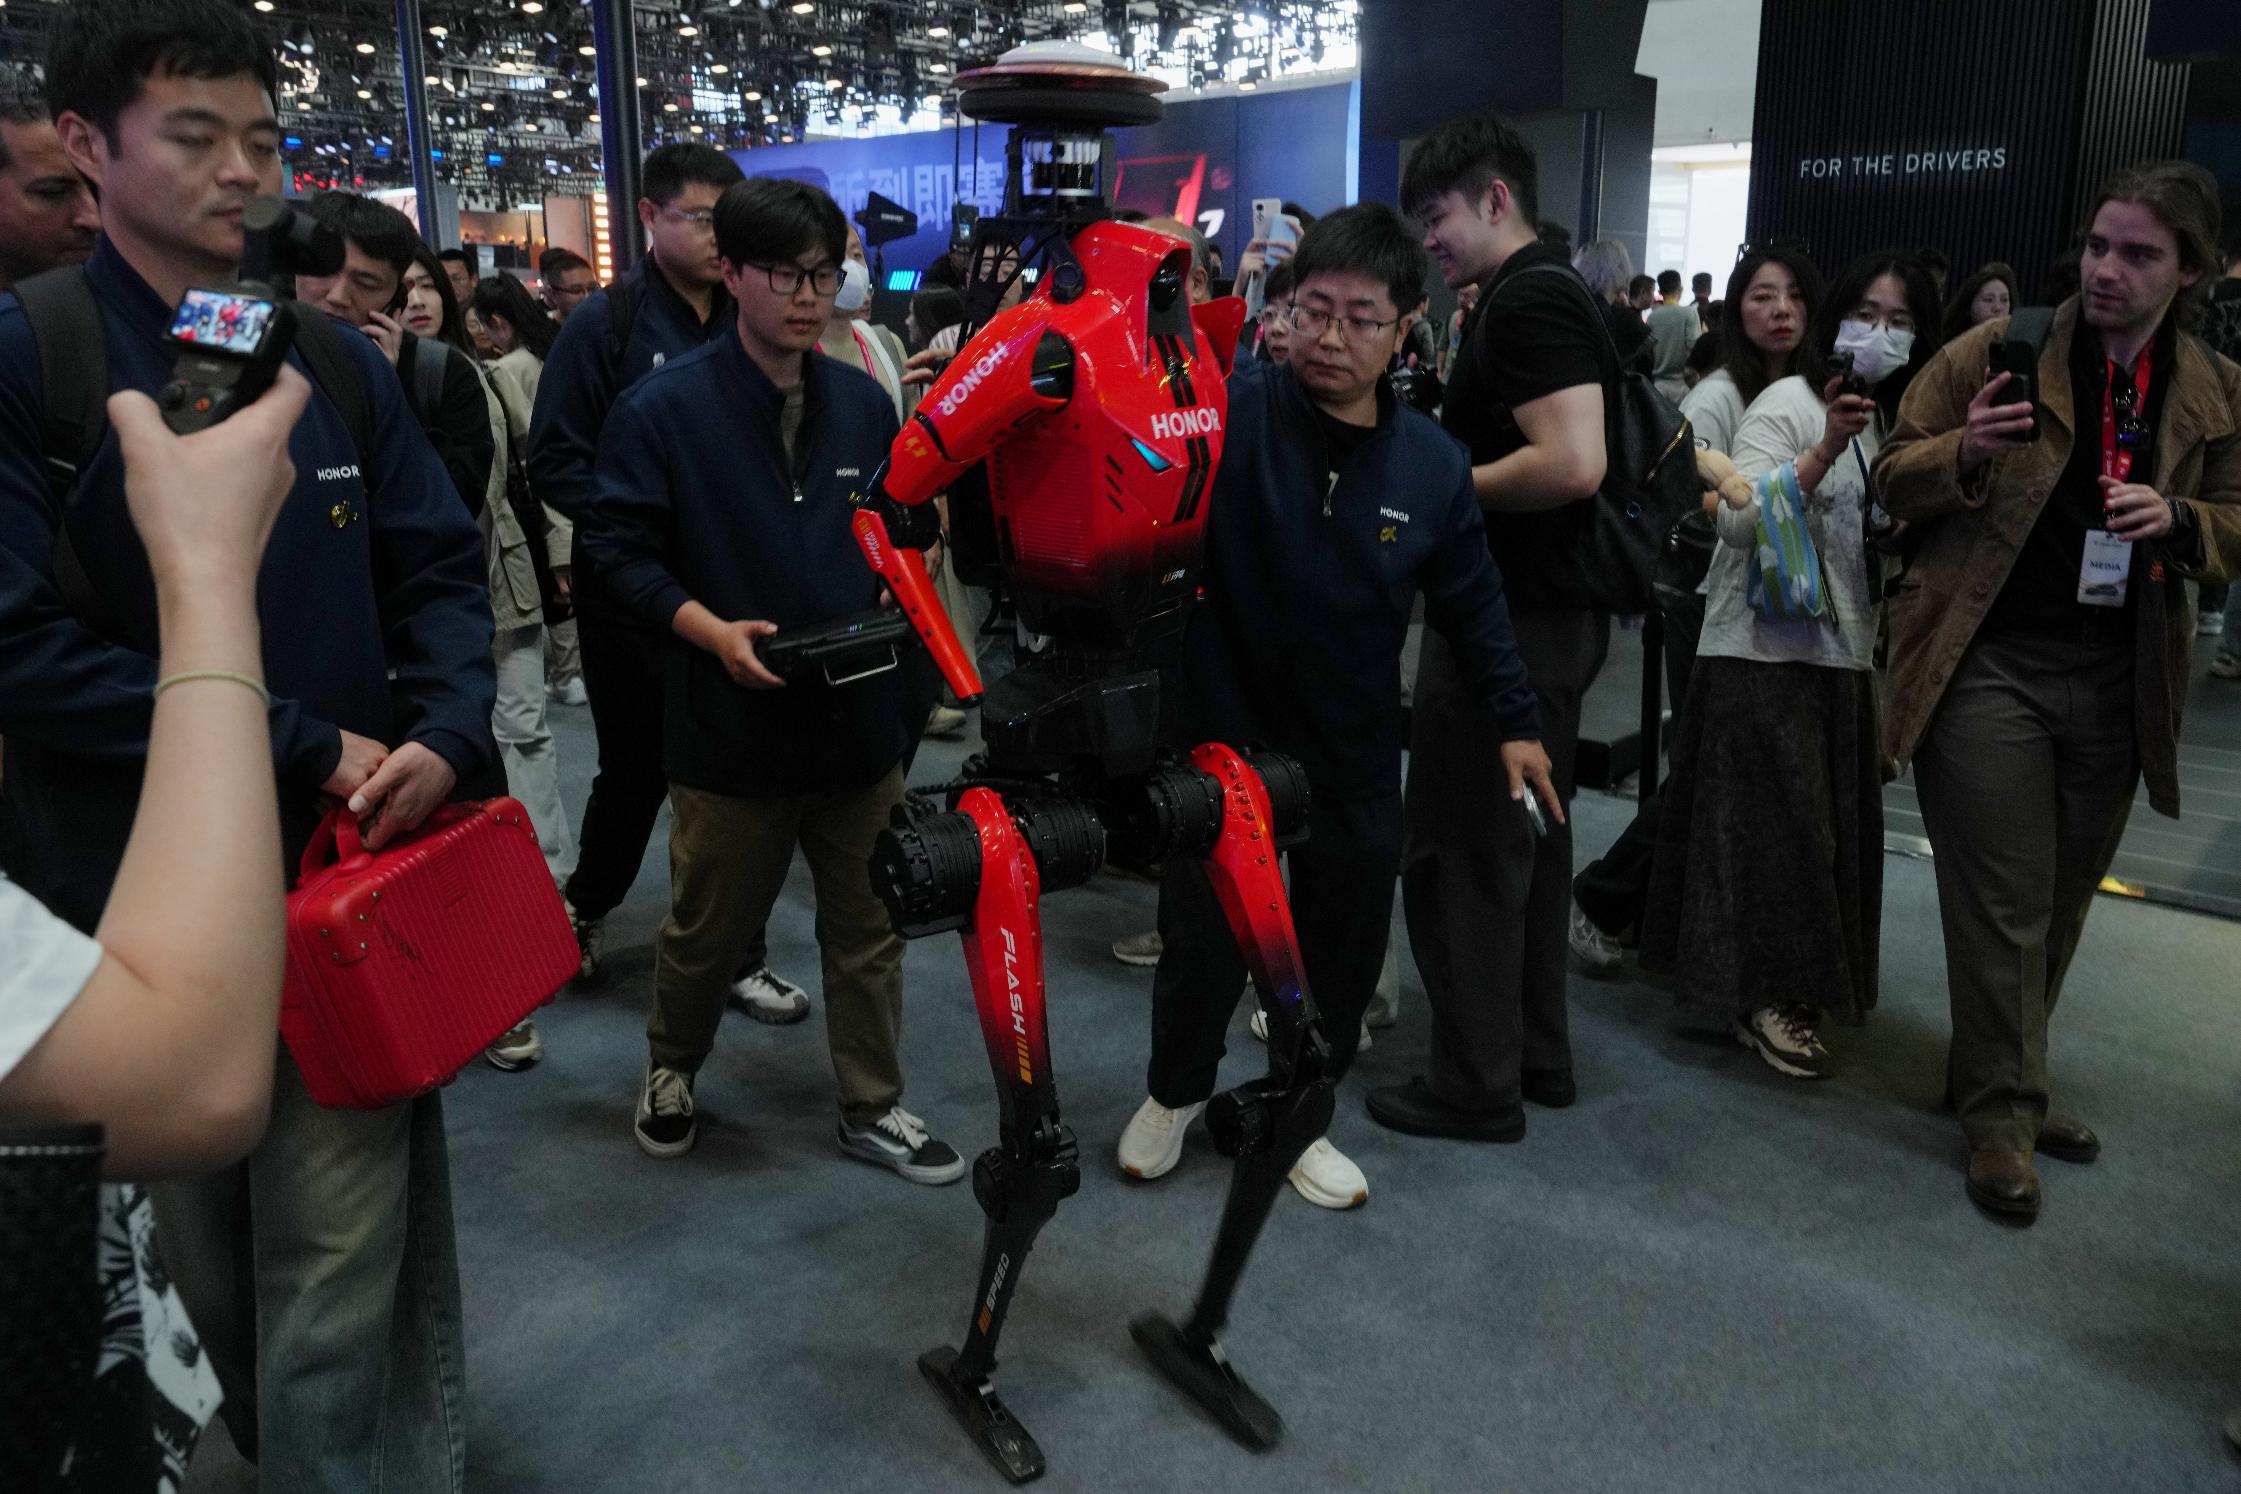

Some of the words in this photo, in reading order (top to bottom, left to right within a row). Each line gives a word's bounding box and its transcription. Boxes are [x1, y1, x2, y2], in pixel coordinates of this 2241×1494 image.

[1800, 159, 1842, 179] FOR
[1852, 154, 1893, 175] THE
[1905, 147, 2006, 174] DRIVERS
[937, 341, 1009, 416] HONOR
[1151, 407, 1222, 440] HONOR
[316, 464, 360, 482] HONOR
[1380, 505, 1410, 524] HONOR
[1000, 927, 1026, 1036] FLASH
[986, 1252, 1010, 1313] SPEED
